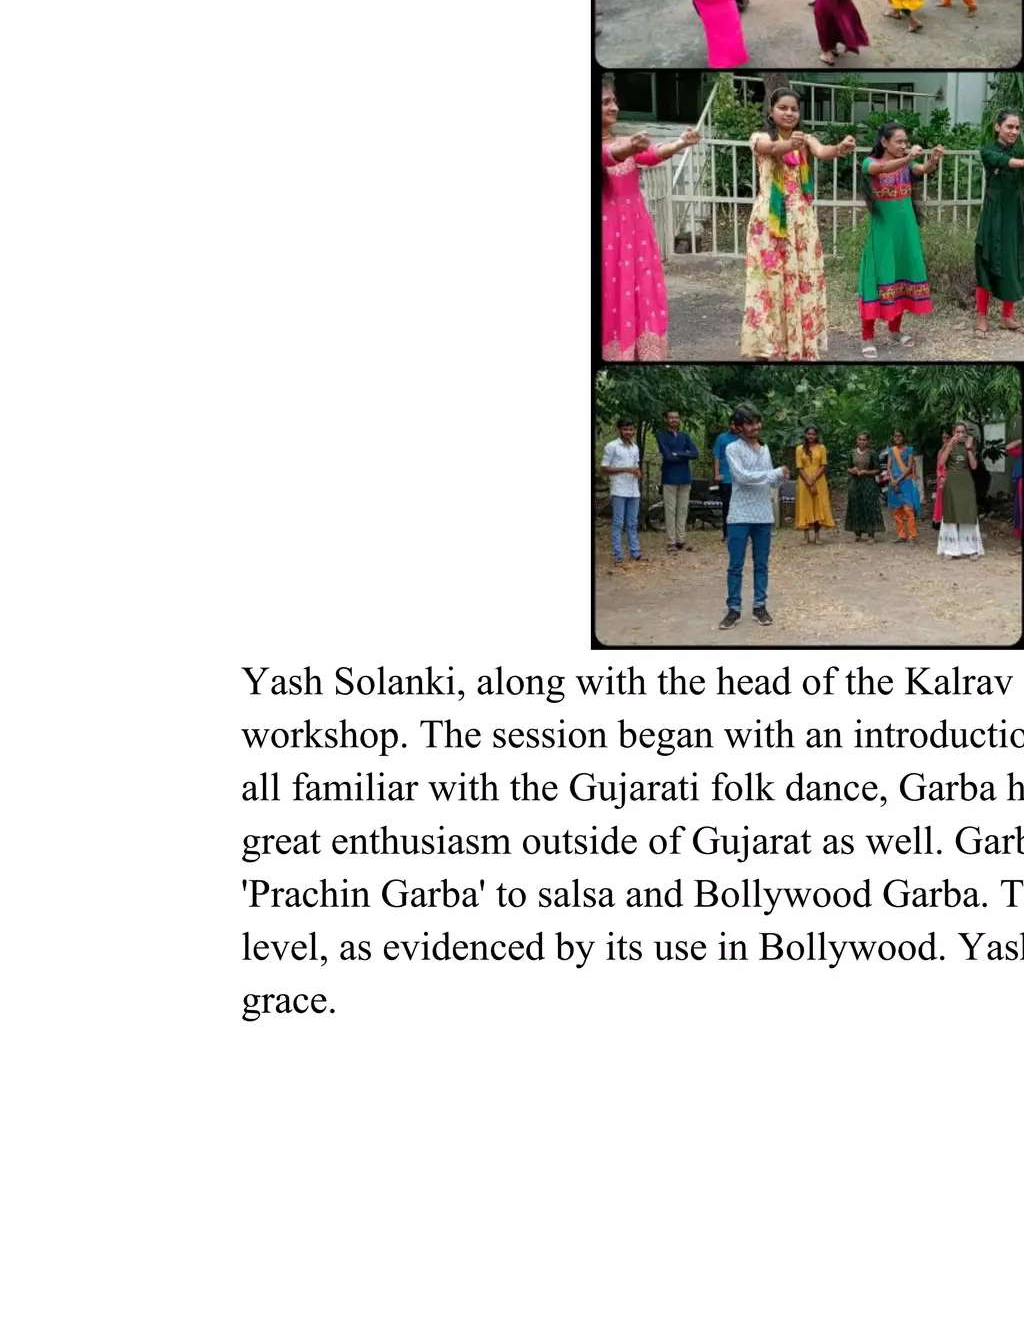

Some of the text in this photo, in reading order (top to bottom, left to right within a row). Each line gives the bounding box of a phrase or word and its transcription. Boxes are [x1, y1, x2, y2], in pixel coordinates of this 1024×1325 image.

[242, 666, 323, 695] Yash
[336, 666, 464, 701] Solanki,
[478, 666, 565, 703] along
[576, 666, 646, 695] with
[657, 666, 705, 695] the
[717, 666, 791, 695] head
[803, 666, 839, 695] of
[846, 666, 893, 695] the
[905, 666, 1013, 695] Kalrav
[241, 719, 407, 756] workshop.
[420, 719, 481, 748] The
[493, 719, 607, 748] session
[618, 719, 713, 756] began
[724, 719, 794, 748] with
[806, 729, 843, 748] an
[242, 772, 280, 801] all
[293, 772, 418, 801] familiar
[428, 772, 499, 801] with
[510, 772, 558, 801] the
[570, 772, 699, 809] Gujarati
[712, 772, 775, 801] folk
[786, 772, 887, 807] dance,
[900, 772, 997, 801] Garba
[242, 830, 321, 862] great
[332, 826, 511, 854] enthusiasm
[523, 826, 637, 854] outside
[649, 826, 686, 854] of
[693, 826, 811, 862] Gujarat
[823, 835, 854, 854] as
[866, 826, 942, 854] well.
[242, 879, 370, 907] 'Prachin
[382, 879, 484, 907] Garba'
[496, 883, 526, 907] to
[539, 879, 615, 907] salsa
[627, 879, 683, 907] and
[694, 879, 872, 915] Bollywood
[883, 879, 987, 907] Garba.
[242, 932, 327, 966] level,
[340, 941, 371, 960] as
[384, 932, 545, 960] evidenced
[555, 932, 595, 968] by
[607, 932, 642, 960] its
[654, 941, 706, 960] use
[719, 932, 748, 960] in
[759, 932, 944, 968] Bollywood.
[242, 994, 335, 1021] grace.
